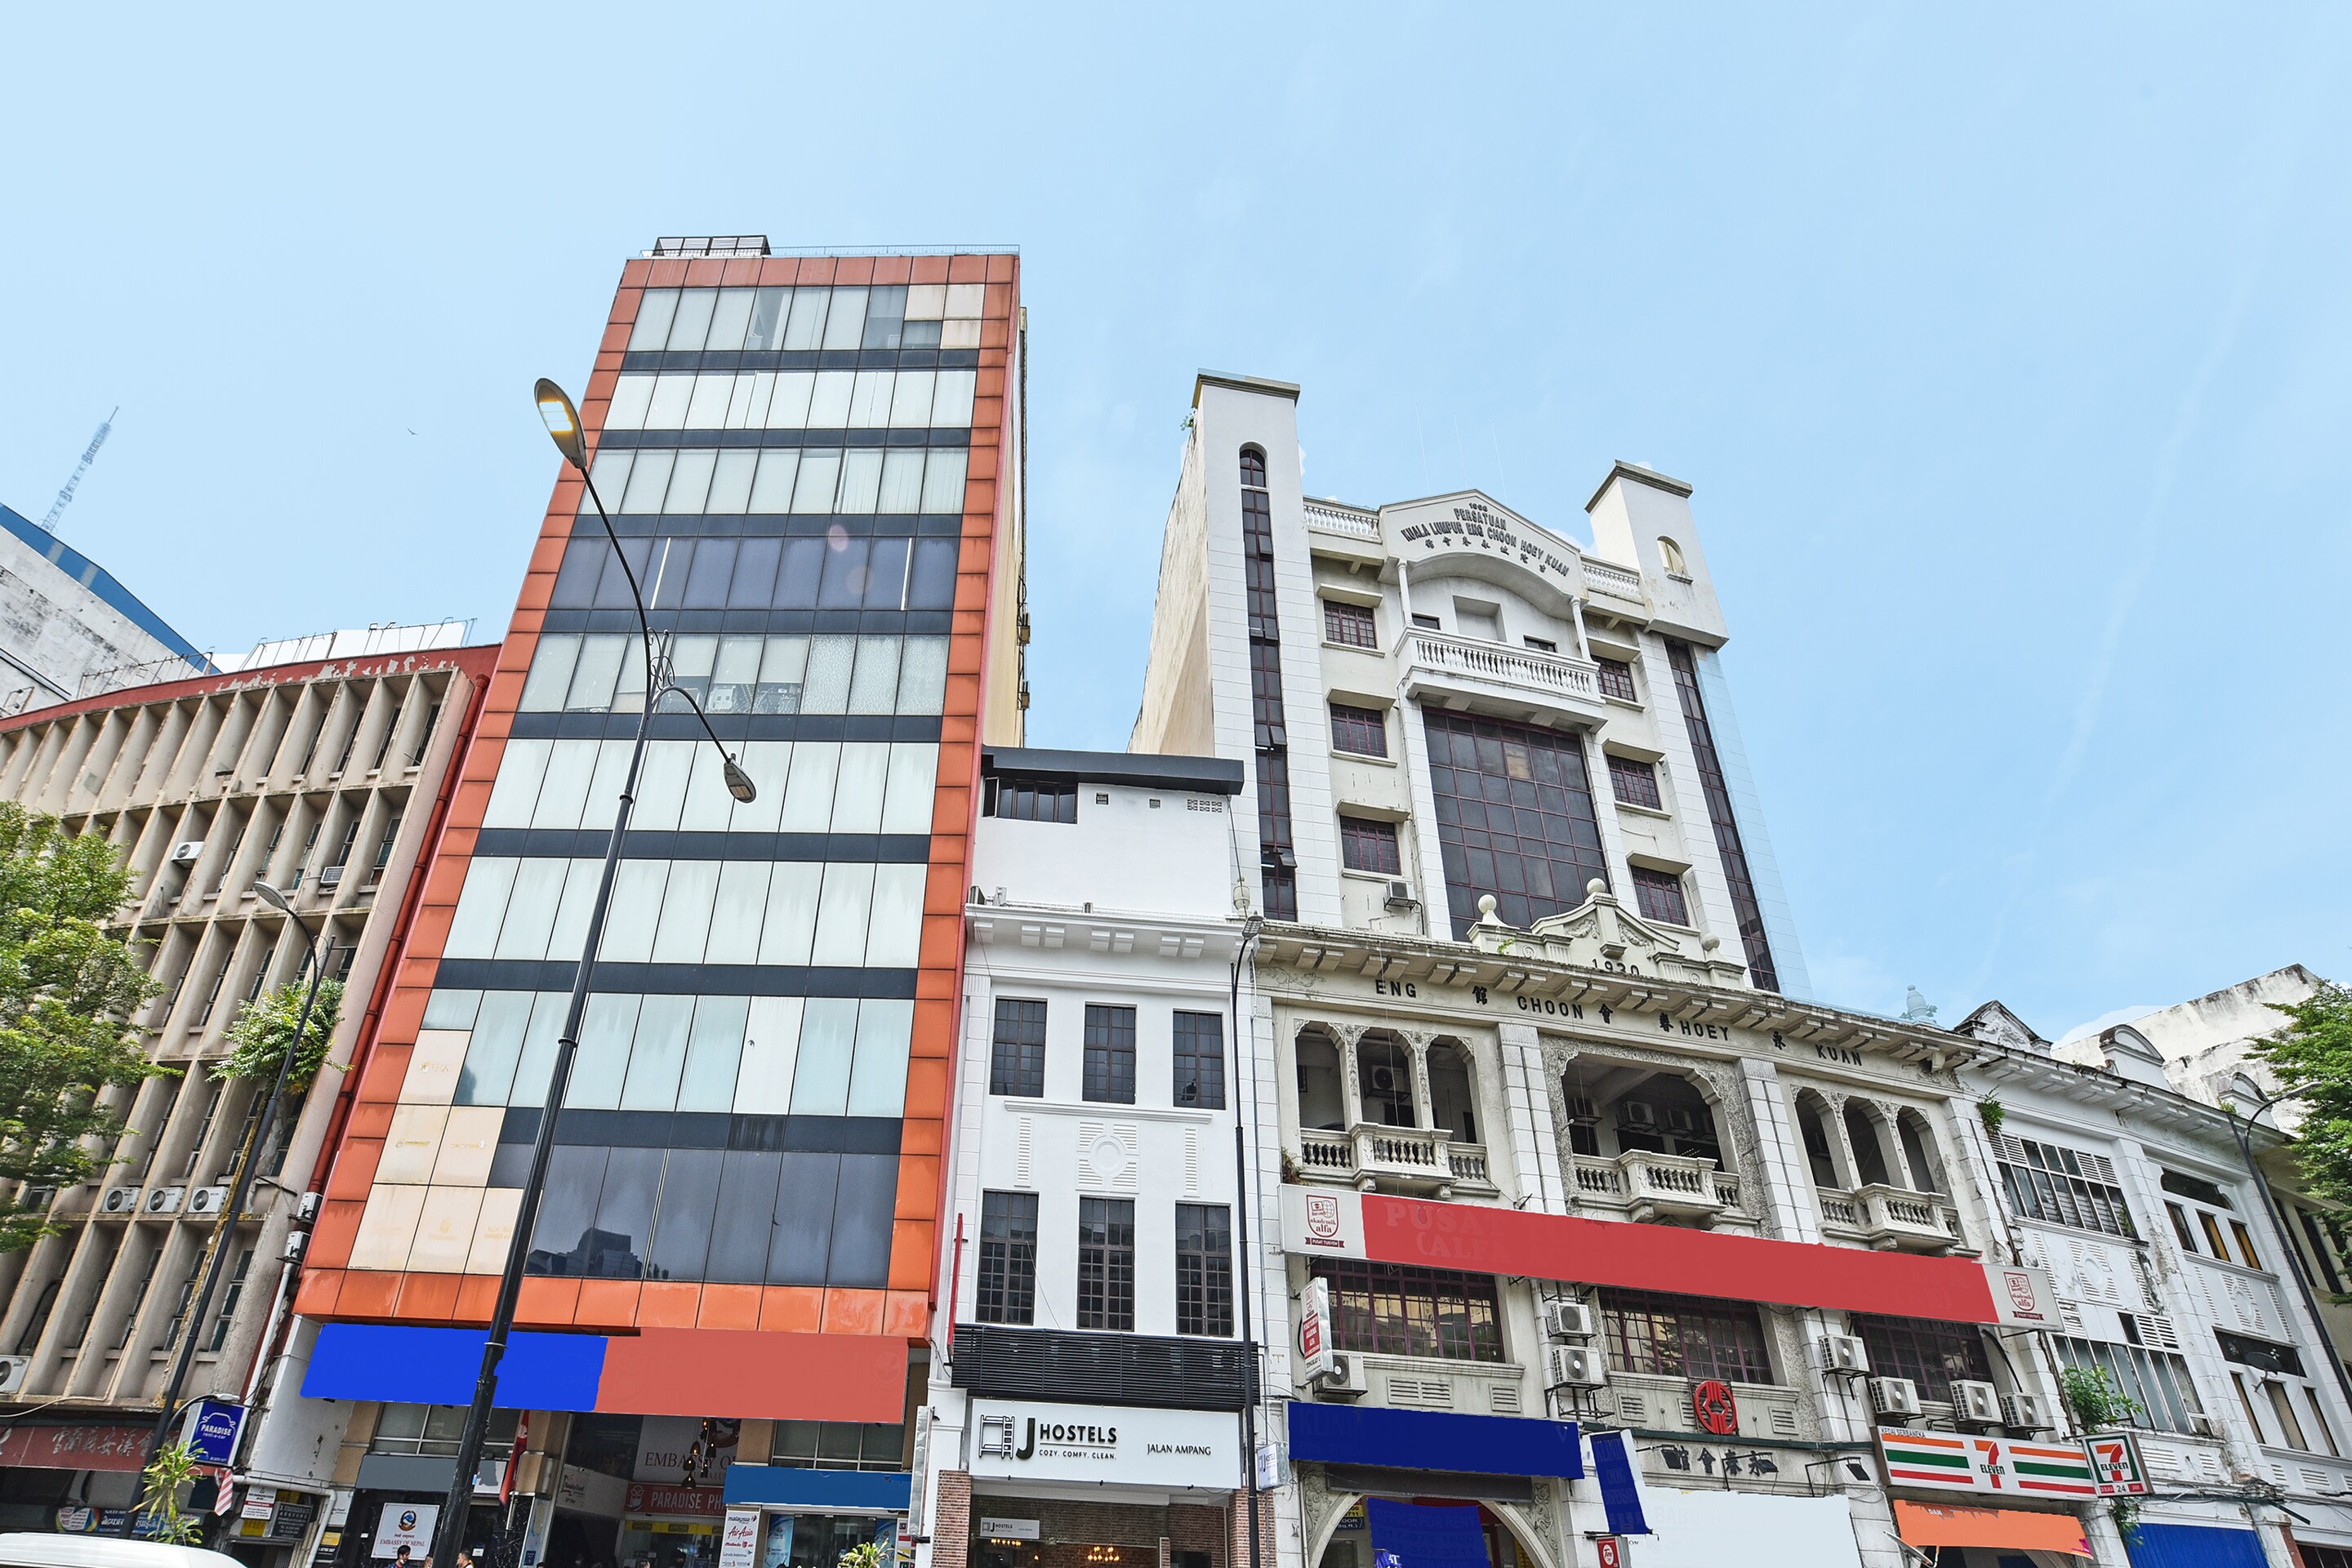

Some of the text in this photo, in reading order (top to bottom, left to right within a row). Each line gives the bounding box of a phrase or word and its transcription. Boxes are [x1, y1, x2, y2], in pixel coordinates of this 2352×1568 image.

[1453, 508, 1507, 531] PERSATUAN
[1401, 521, 1570, 577] KUALA LUMPUR ENG CHOON HOEY KUAN
[1376, 979, 1863, 1067] ENG CHOON HOEY KUAN
[1316, 1224, 1332, 1233] alfa
[201, 1424, 233, 1436] PARADISE
[1015, 1417, 1117, 1459] J HOSTELS
[1062, 1450, 1089, 1459] COMFY.
[1092, 1452, 1116, 1460] CLEAN.
[1147, 1444, 1211, 1455] JALAN AMPANG
[644, 1451, 716, 1469] EMBASY
[2116, 1485, 2127, 1493] 24
[651, 1491, 702, 1509] PARADISE
[990, 1522, 995, 1532] J
